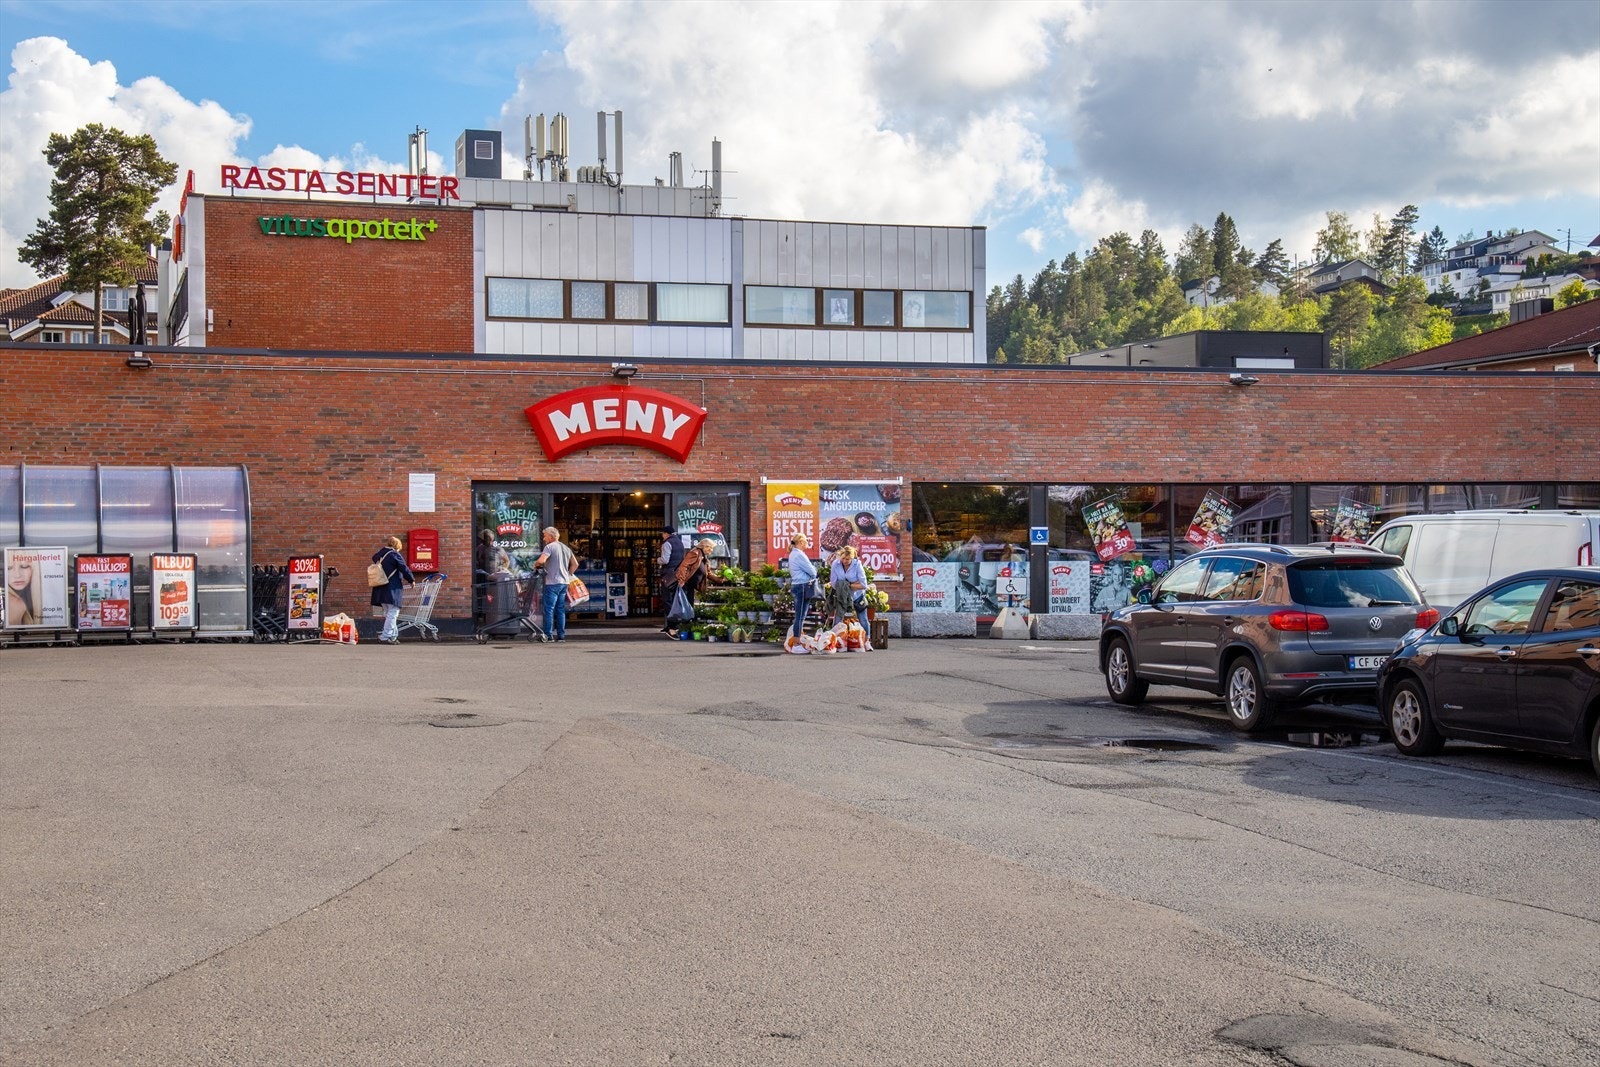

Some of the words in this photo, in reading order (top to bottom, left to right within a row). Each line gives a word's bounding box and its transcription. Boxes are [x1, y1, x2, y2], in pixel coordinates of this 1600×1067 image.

[221, 164, 327, 193] RASTA
[336, 171, 460, 199] SENTER
[548, 398, 691, 441] MENY
[823, 490, 850, 499] FERSK
[823, 501, 886, 510] ANGUSBURGER
[497, 509, 537, 521] ENDELIG
[773, 520, 813, 536] BESTE
[773, 537, 813, 549] UTVG
[80, 563, 127, 572] KNALLKJØP
[154, 555, 192, 569] TILBUD
[294, 559, 313, 572] 30%
[1052, 605, 1071, 613] UTVALG
[1359, 657, 1369, 667] CF
